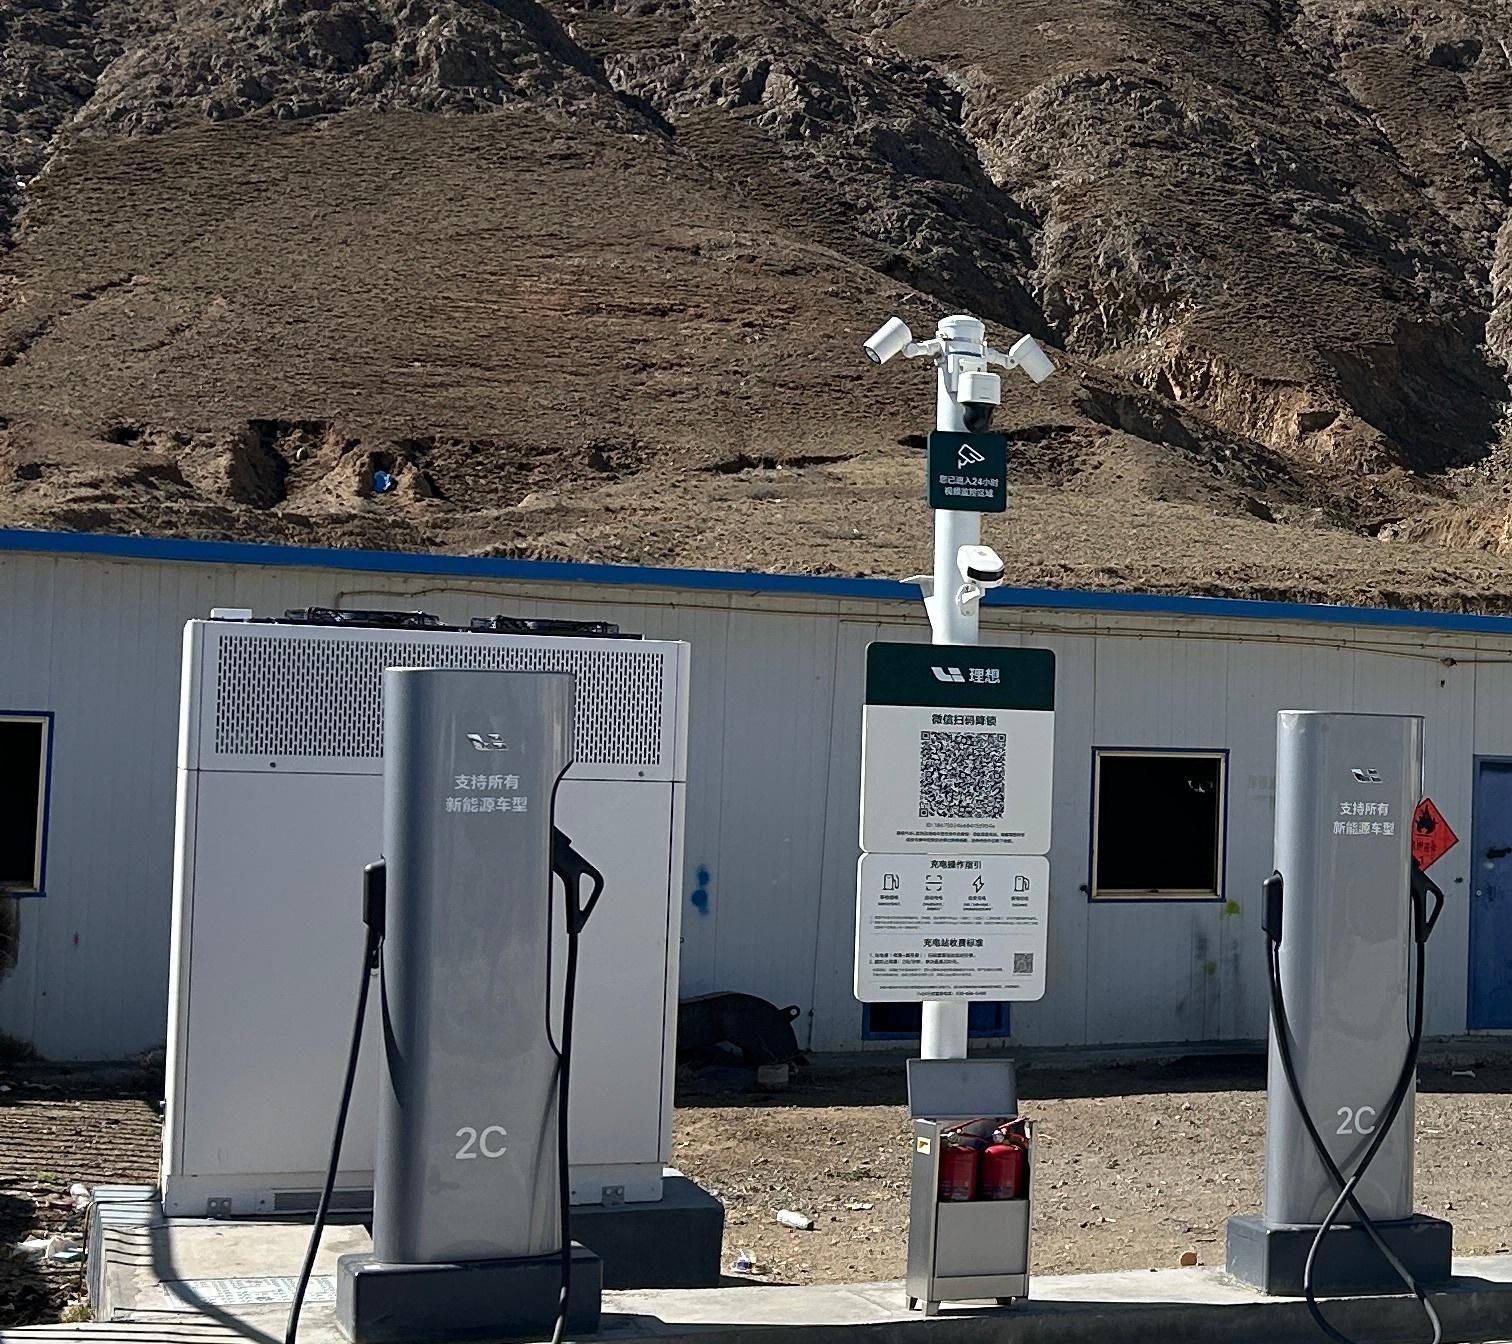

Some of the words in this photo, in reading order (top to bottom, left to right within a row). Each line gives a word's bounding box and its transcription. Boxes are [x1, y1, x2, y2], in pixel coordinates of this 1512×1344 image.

[968, 668, 1001, 684] 理想
[931, 713, 997, 727] 微信扫码降锁
[454, 774, 520, 790] 支持所有
[445, 796, 528, 813] 新能源车型
[1339, 801, 1390, 816] 支持所有
[1333, 820, 1396, 836] 新能源车型
[929, 859, 983, 870] 充电操作指引
[923, 937, 985, 948] 充电站收费标准
[1336, 1105, 1377, 1136] 2C
[454, 1125, 508, 1161] 2C
